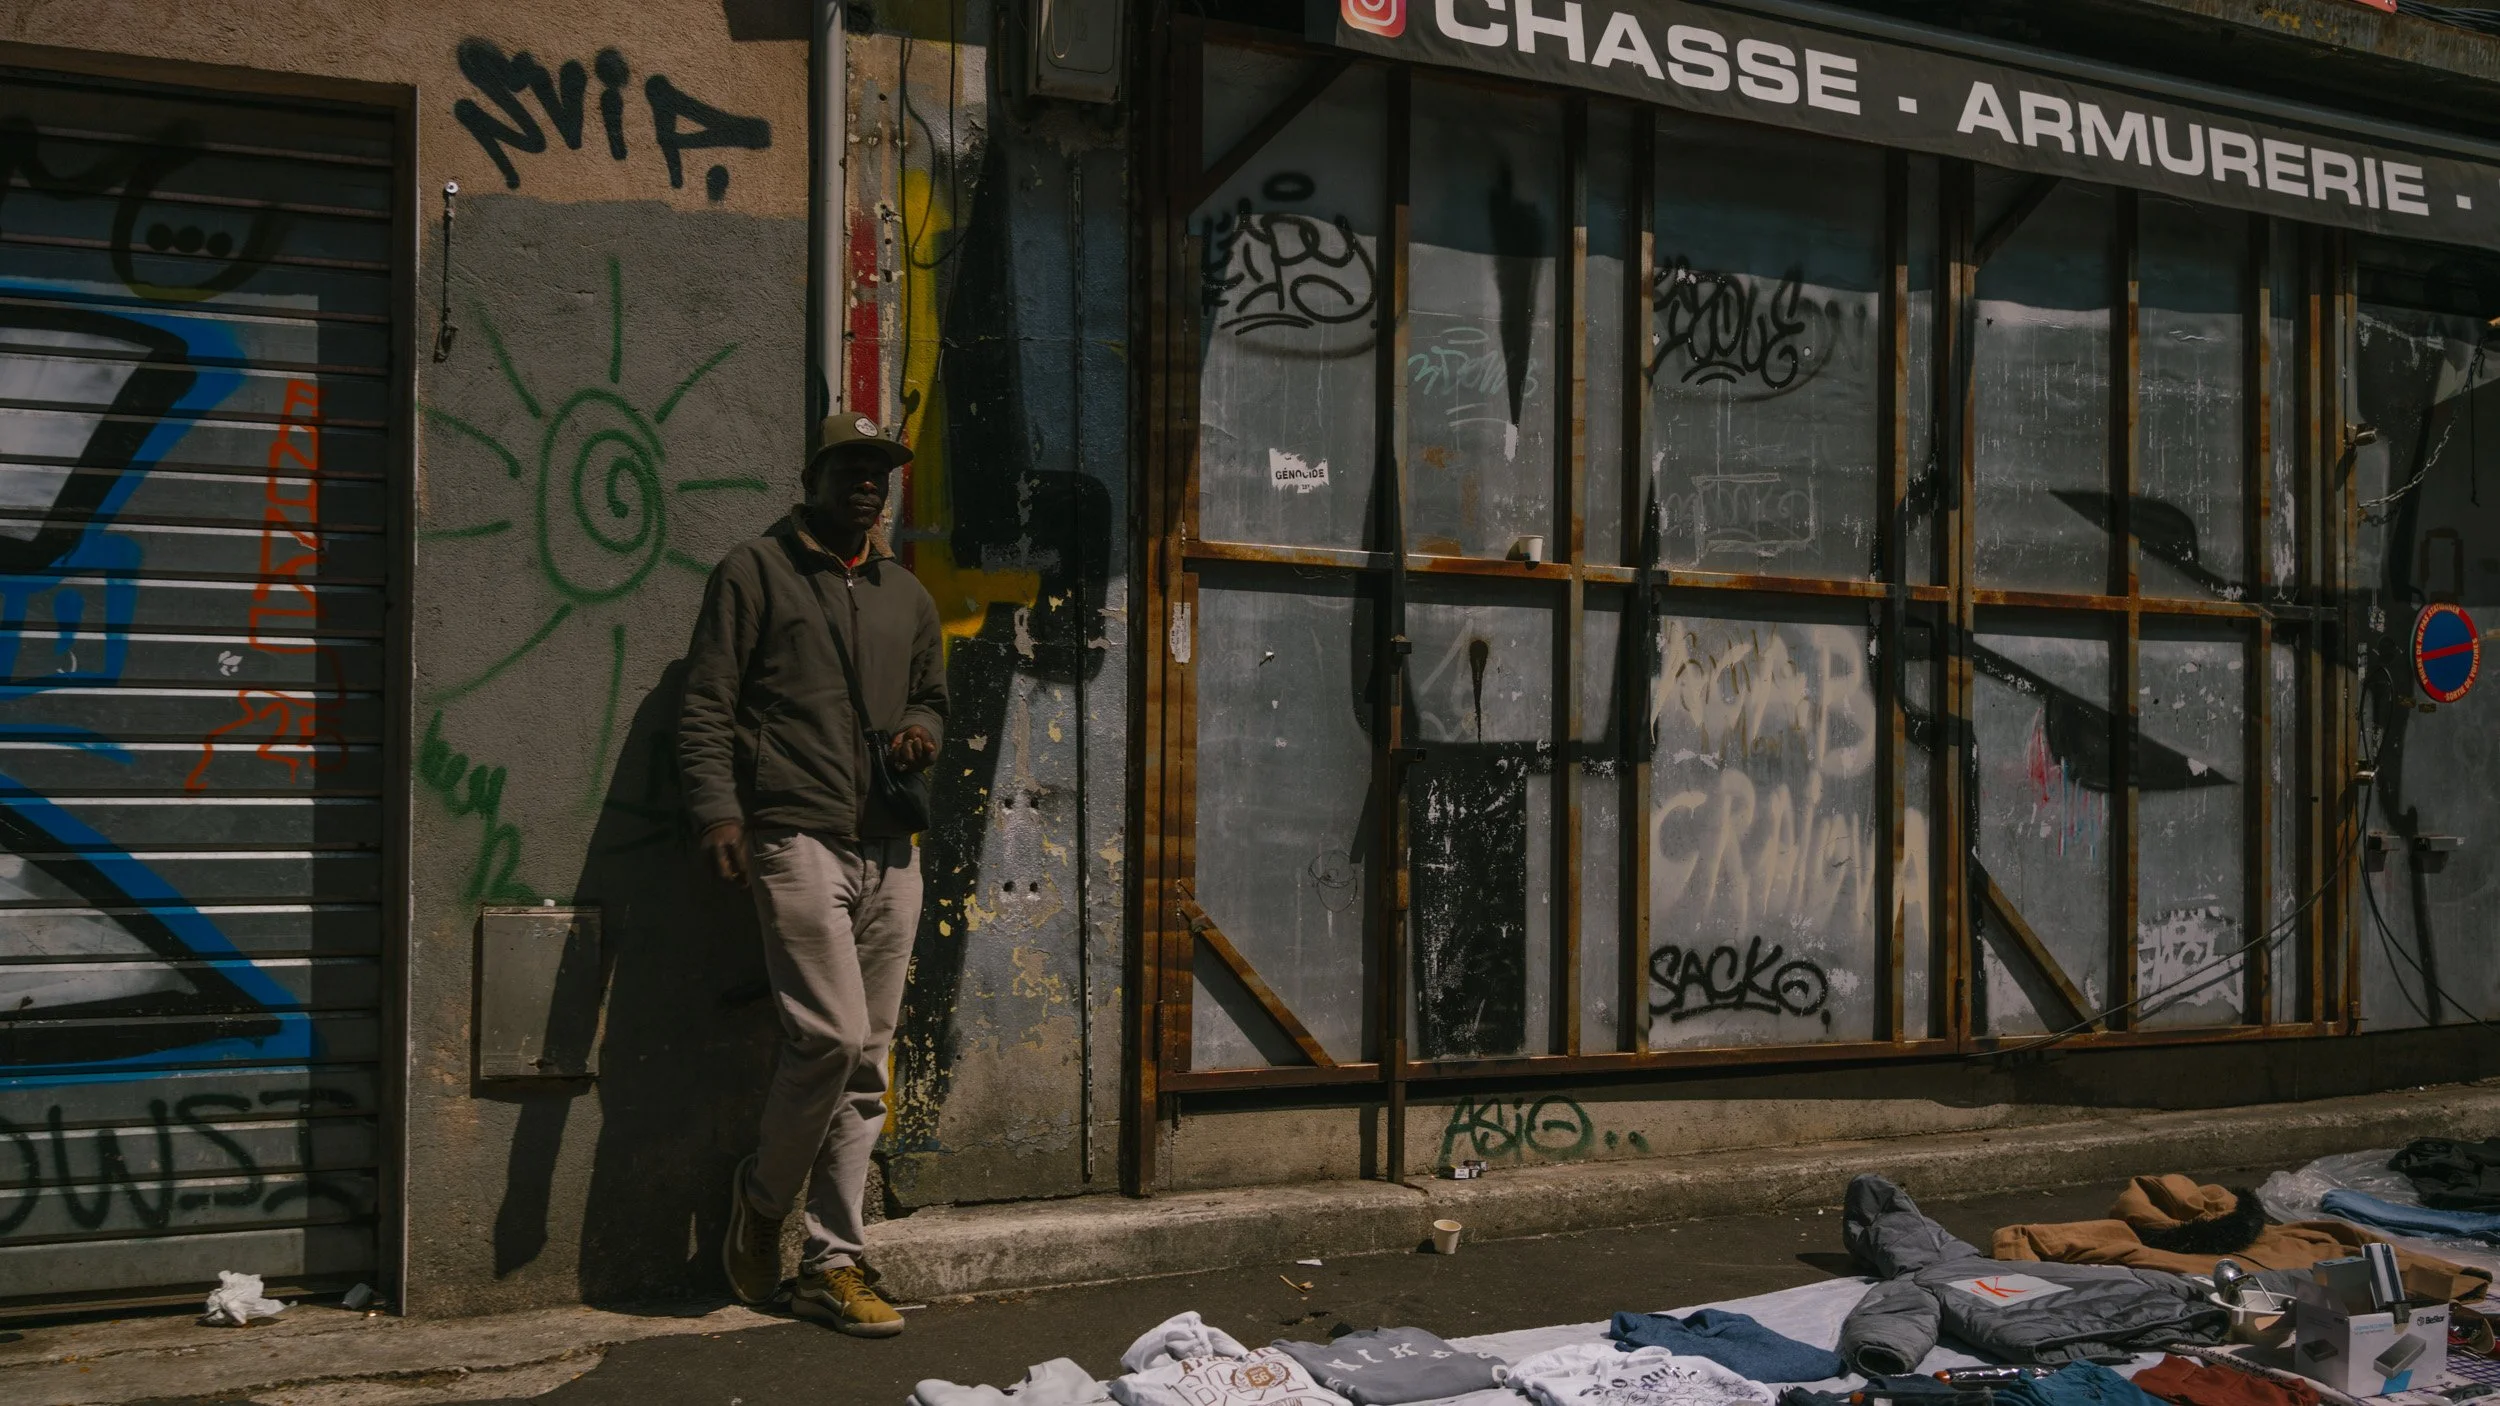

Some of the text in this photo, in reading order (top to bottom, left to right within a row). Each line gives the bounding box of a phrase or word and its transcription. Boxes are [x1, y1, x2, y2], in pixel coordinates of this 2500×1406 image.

[1435, 0, 2430, 216] CHASSE ARMURERIE
[1275, 467, 1325, 480] GÉNOCIDE
[2420, 613, 2430, 630] PAS
[2445, 638, 2480, 701] SORTIE DE VOITURES
